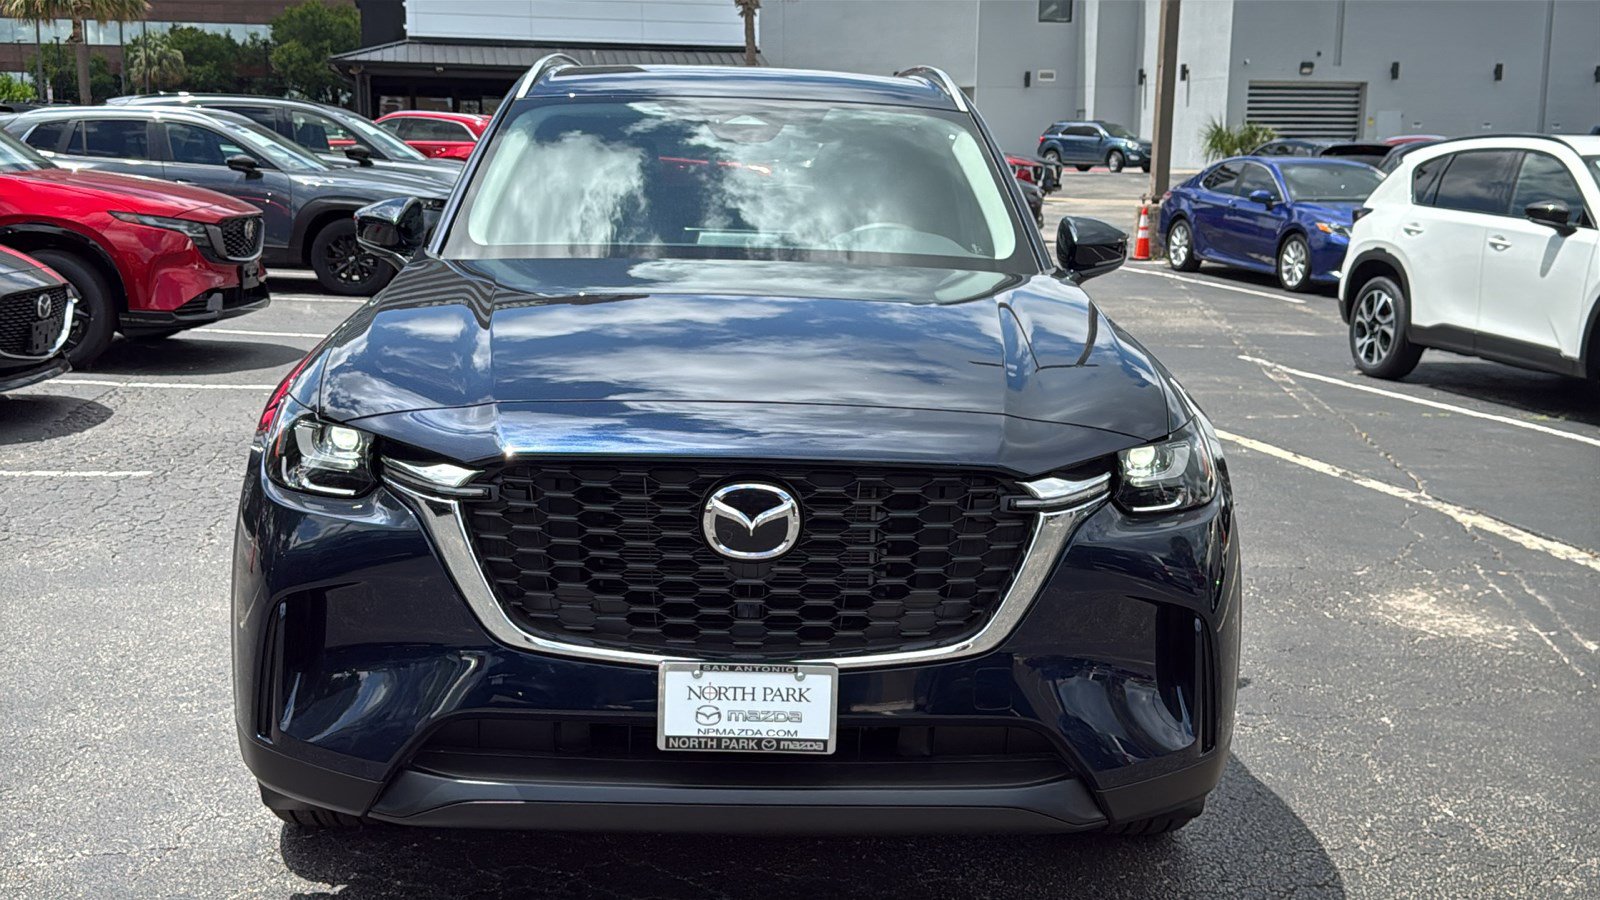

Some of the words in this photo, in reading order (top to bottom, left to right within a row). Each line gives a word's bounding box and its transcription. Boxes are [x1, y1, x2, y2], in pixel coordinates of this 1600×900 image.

[687, 685, 755, 701] NORTH
[762, 687, 811, 702] PARK
[698, 728, 798, 737] NPMAZDA.COM
[669, 738, 717, 748] NORTH
[722, 739, 758, 749] PARK
